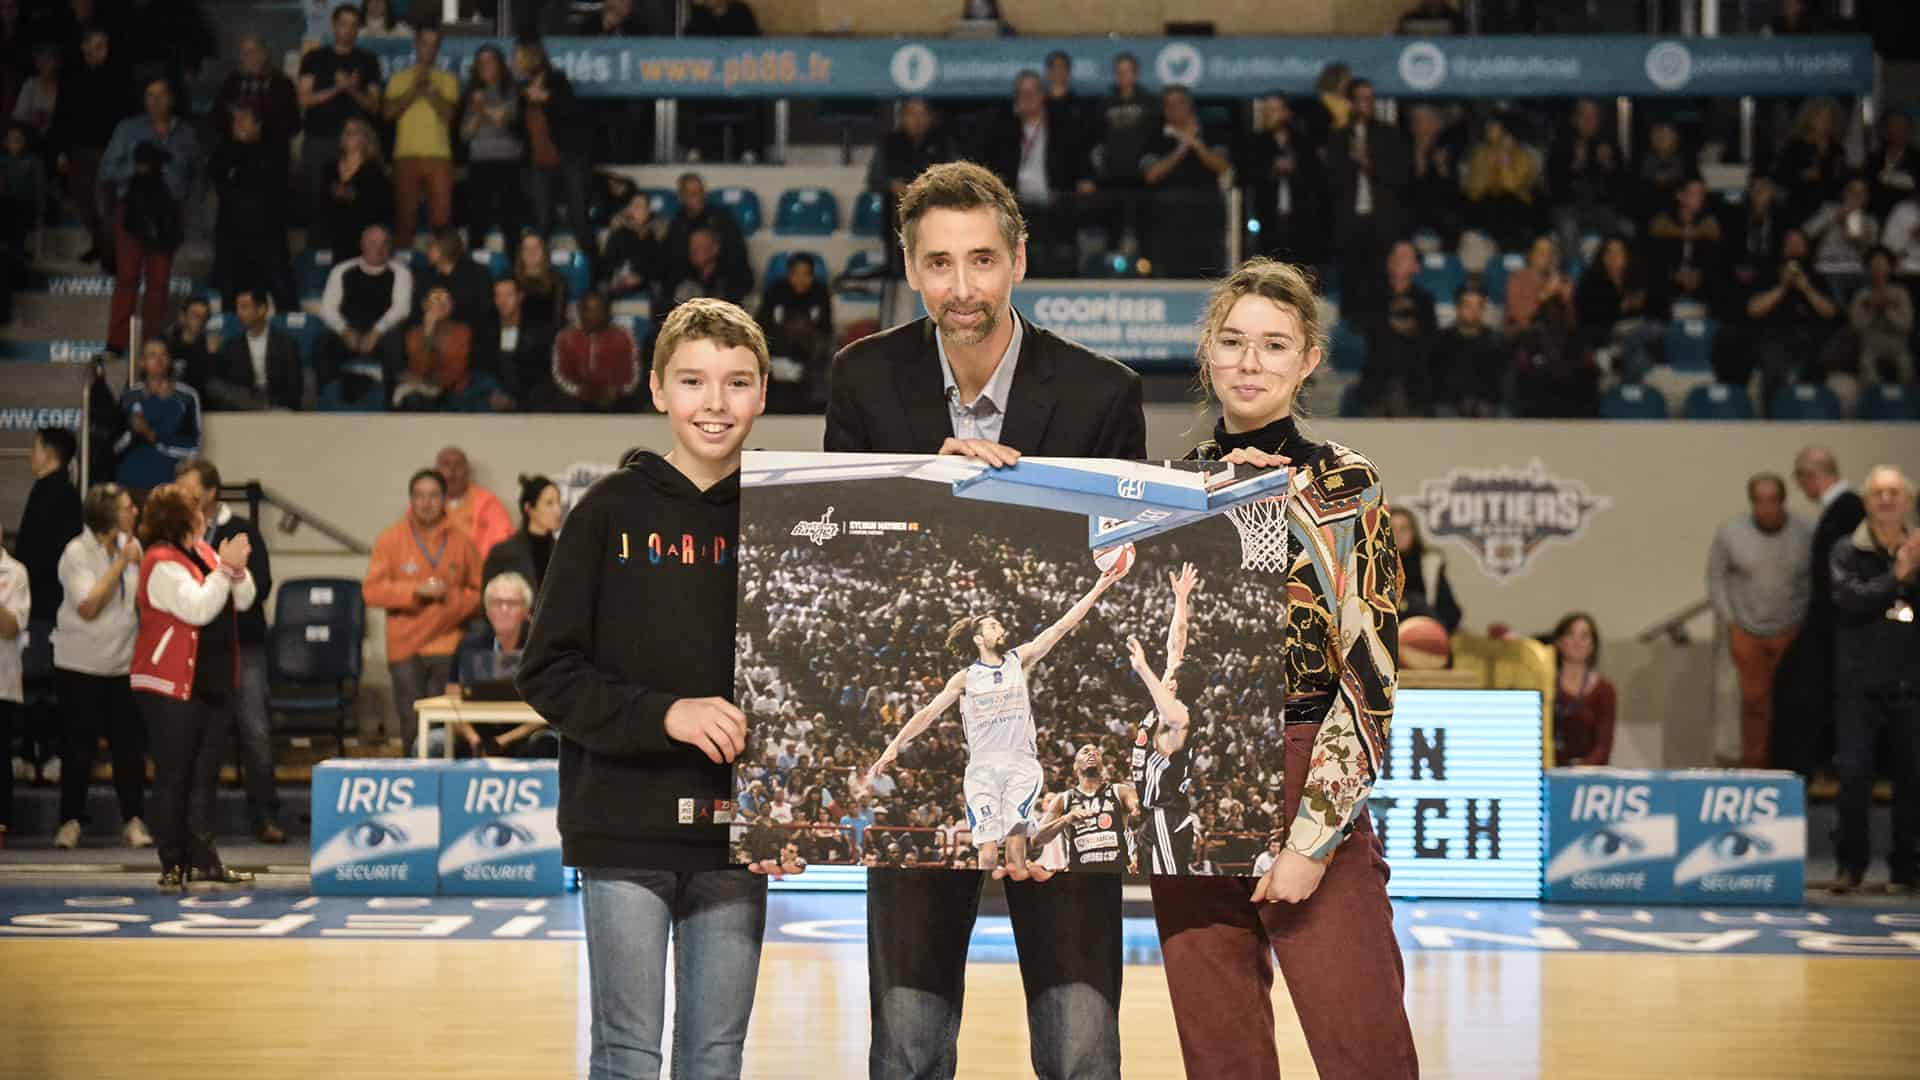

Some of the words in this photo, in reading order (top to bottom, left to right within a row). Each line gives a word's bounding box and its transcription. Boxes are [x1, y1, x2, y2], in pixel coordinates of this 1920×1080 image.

[1429, 489, 1579, 530] POITIERS
[336, 777, 416, 813] IRIS
[464, 778, 543, 814] IRIS
[1570, 785, 1651, 821] IRIS
[1700, 787, 1780, 824] IRIS
